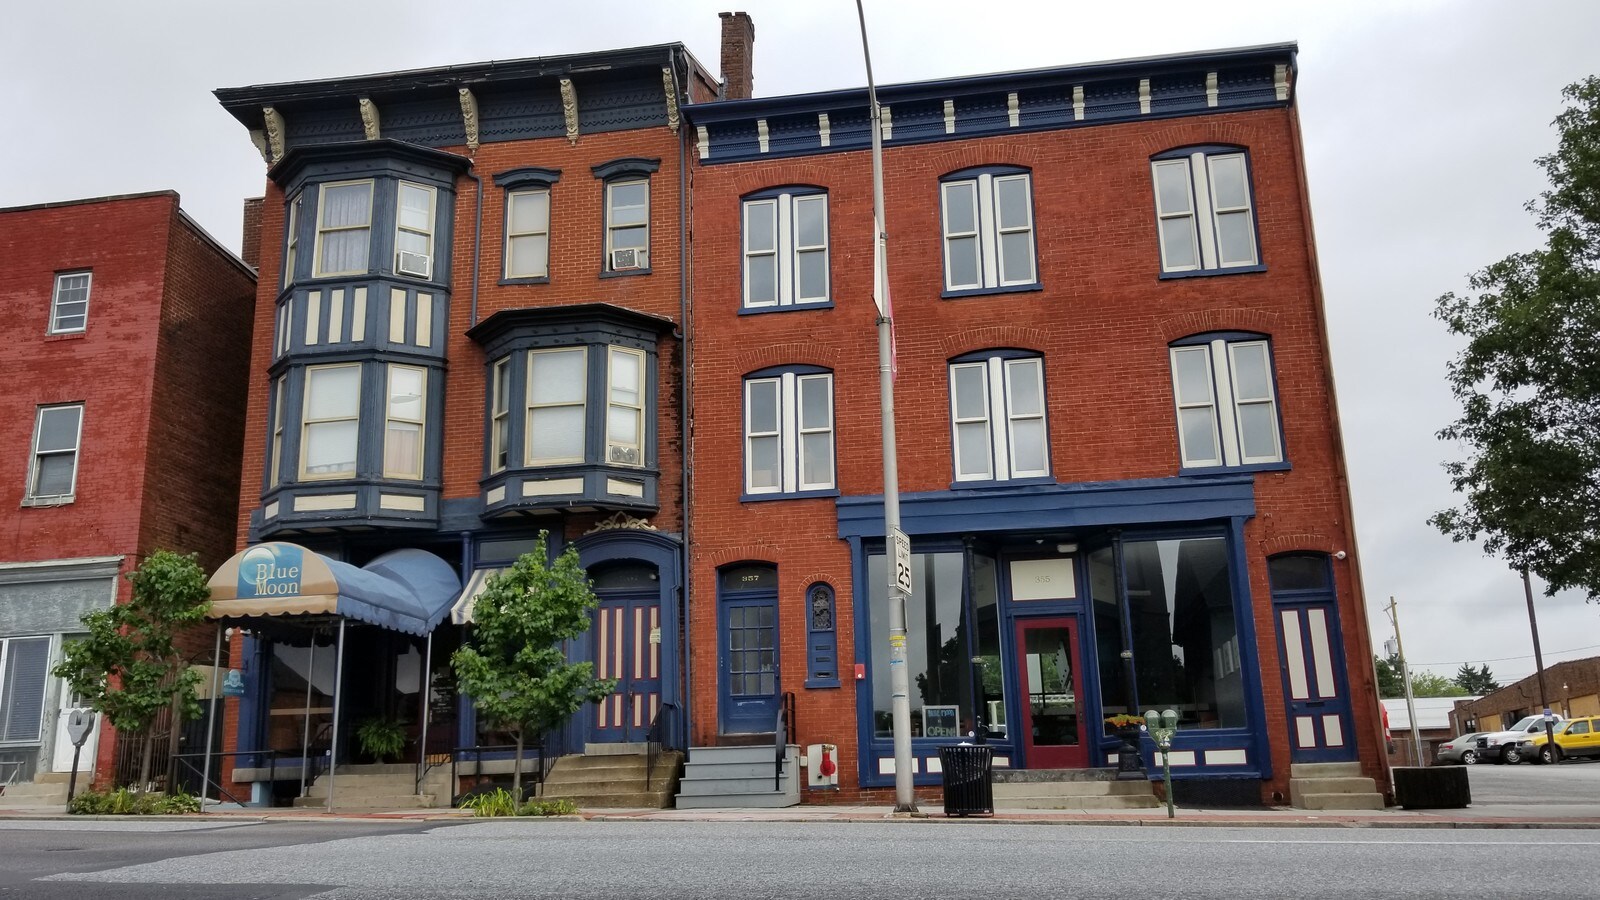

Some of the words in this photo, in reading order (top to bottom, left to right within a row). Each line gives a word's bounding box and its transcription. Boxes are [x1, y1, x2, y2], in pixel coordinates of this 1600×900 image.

[896, 535, 909, 551] SPEED
[897, 548, 909, 563] LIMIT
[256, 563, 299, 580] Blue
[898, 562, 910, 588] 25
[1034, 575, 1051, 584] 355
[254, 579, 299, 596] Moon
